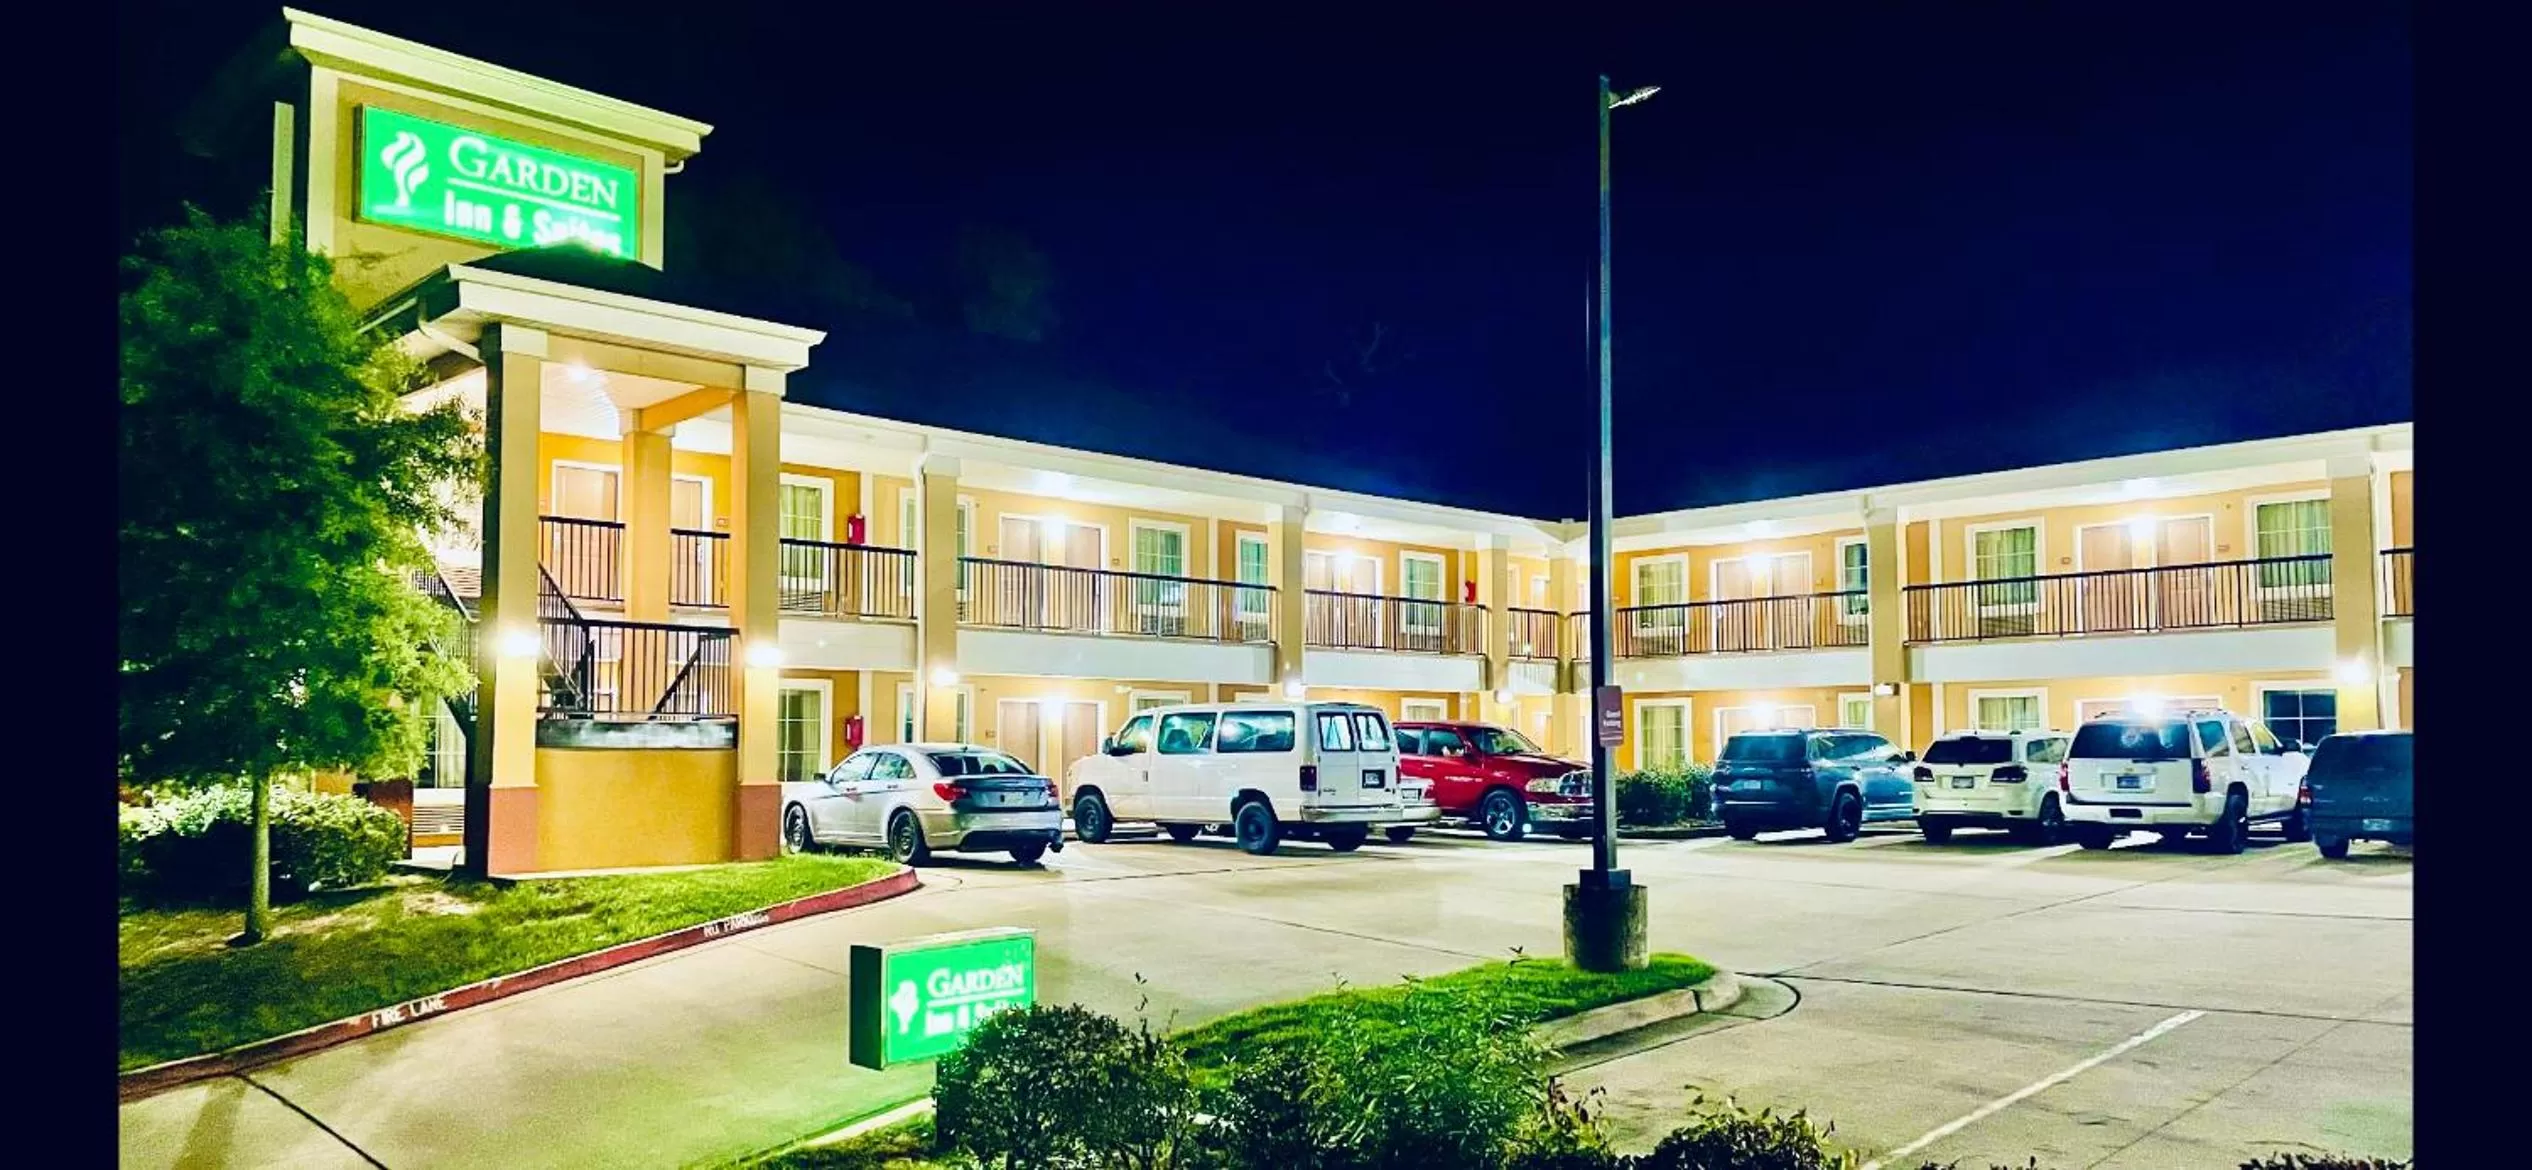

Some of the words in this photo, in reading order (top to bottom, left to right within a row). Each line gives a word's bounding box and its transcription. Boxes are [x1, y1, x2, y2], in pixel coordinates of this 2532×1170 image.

[449, 135, 619, 209] GARDEN
[445, 189, 492, 234] Inn
[502, 203, 522, 240] &
[926, 962, 1025, 999] GARDEN
[371, 1007, 406, 1029] FIRE
[409, 997, 448, 1017] LANE
